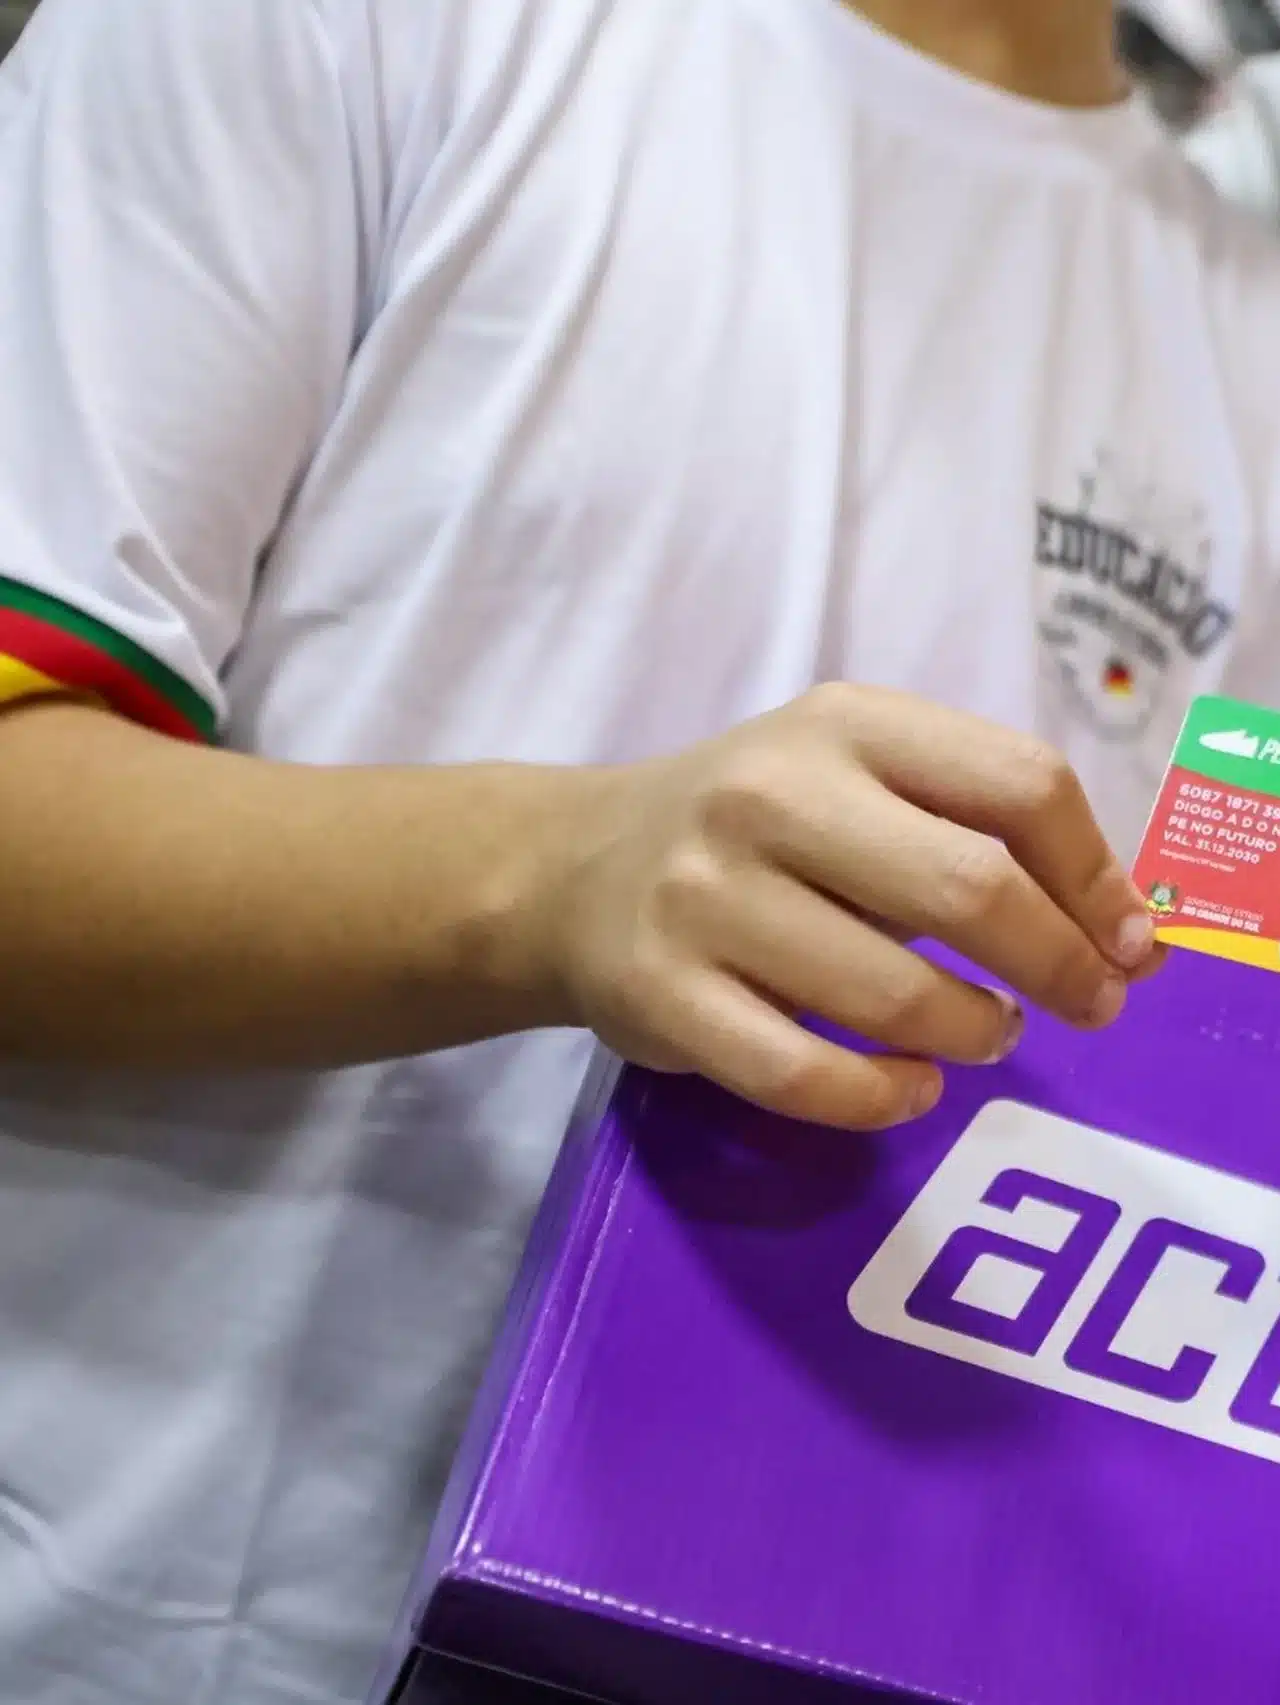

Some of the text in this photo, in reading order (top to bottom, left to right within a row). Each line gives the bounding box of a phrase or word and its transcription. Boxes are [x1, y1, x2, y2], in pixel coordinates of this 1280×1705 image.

[1179, 784, 1222, 803] 6087
[1226, 795, 1260, 814] 1871
[1174, 800, 1224, 820] DIOGO
[1226, 813, 1238, 826] A
[1241, 816, 1254, 828] D
[1256, 820, 1268, 833] O
[1163, 830, 1193, 847] VAL.
[1168, 815, 1278, 852] PE NO FUTURO
